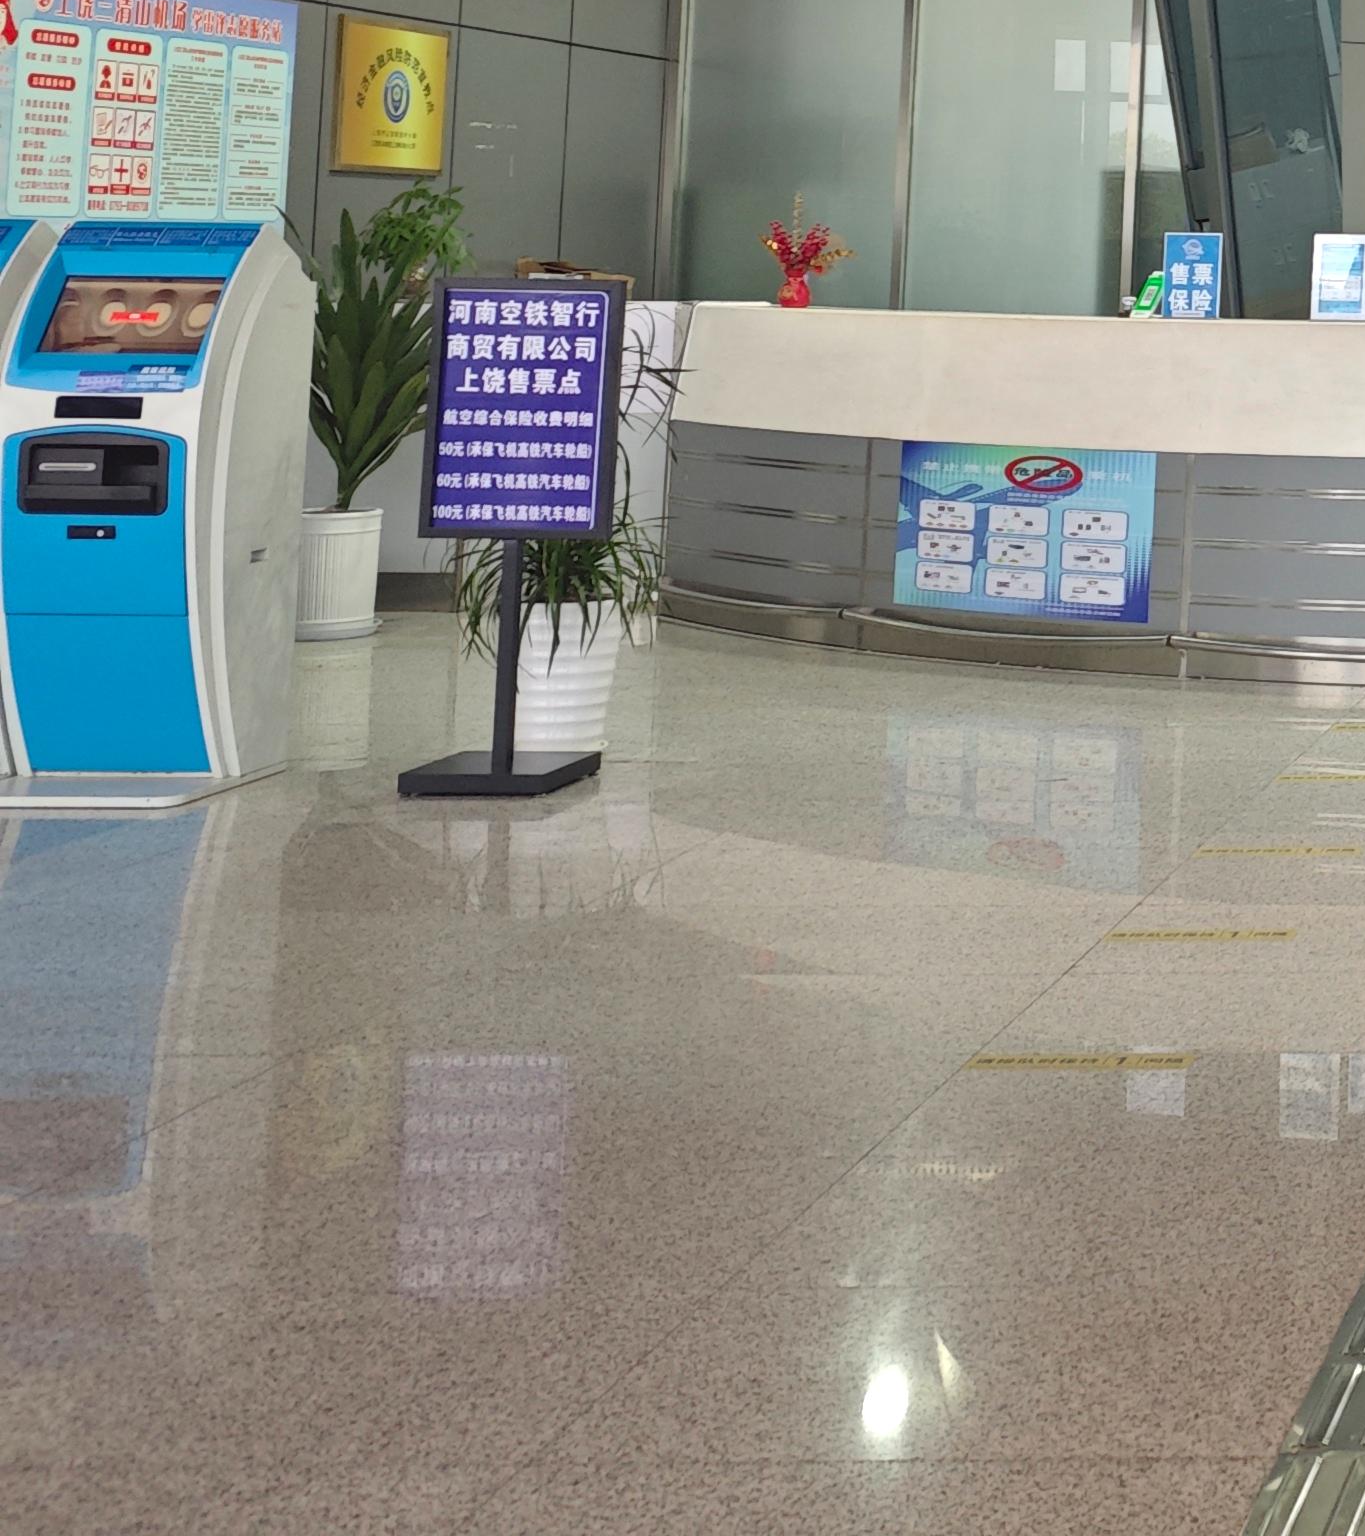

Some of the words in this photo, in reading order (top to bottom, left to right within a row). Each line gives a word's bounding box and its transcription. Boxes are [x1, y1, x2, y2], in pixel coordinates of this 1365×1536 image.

[1170, 262, 1214, 285] 售票
[448, 299, 600, 328] 河南空铁智行
[1168, 288, 1213, 311] 保险
[446, 334, 597, 362] 商贸有限公司
[456, 367, 582, 395] 上饶售票点
